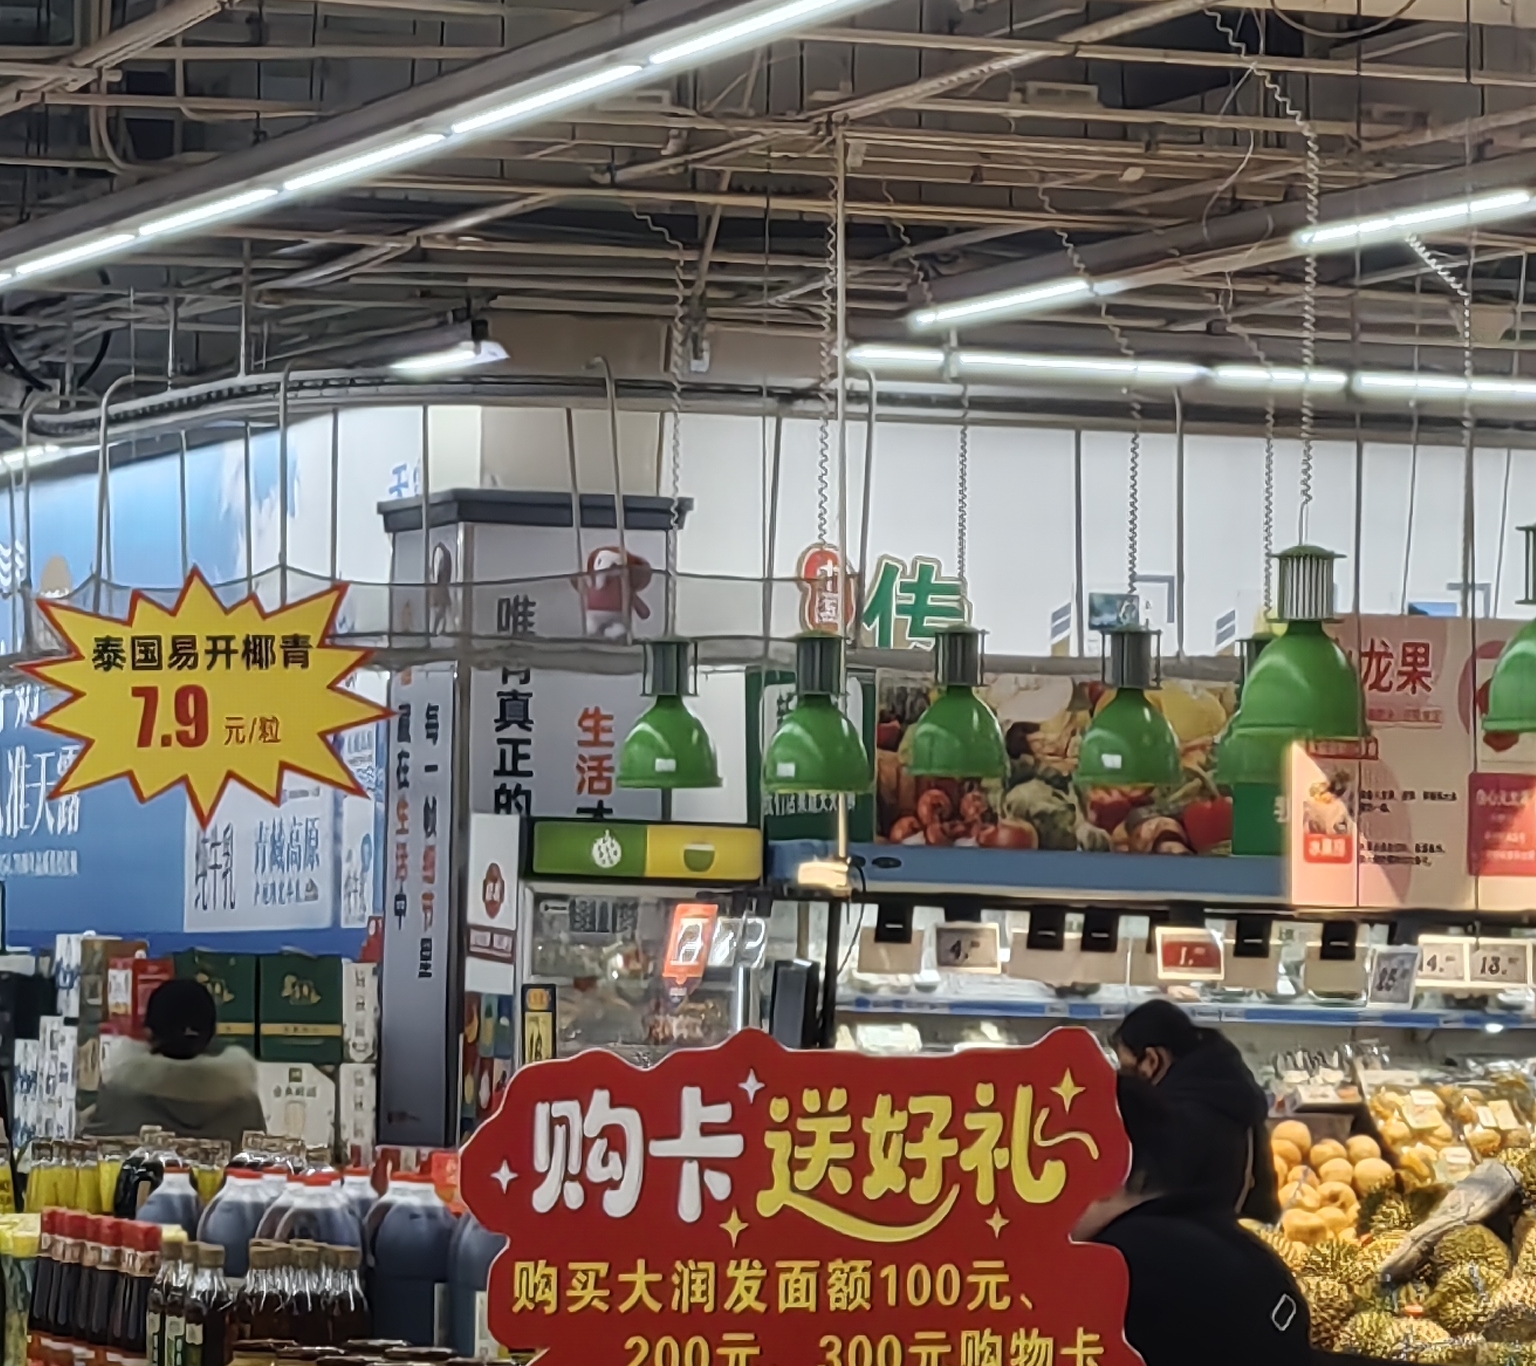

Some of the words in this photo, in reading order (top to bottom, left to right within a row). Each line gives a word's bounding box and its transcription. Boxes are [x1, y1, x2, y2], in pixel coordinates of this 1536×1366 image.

[91, 634, 311, 672] 泰国易开椰青
[1348, 638, 1432, 694] 龙果
[132, 685, 209, 748] 7.9
[225, 716, 281, 745] 元/粒
[513, 1258, 1040, 1315] 购买大润发面额100元、
